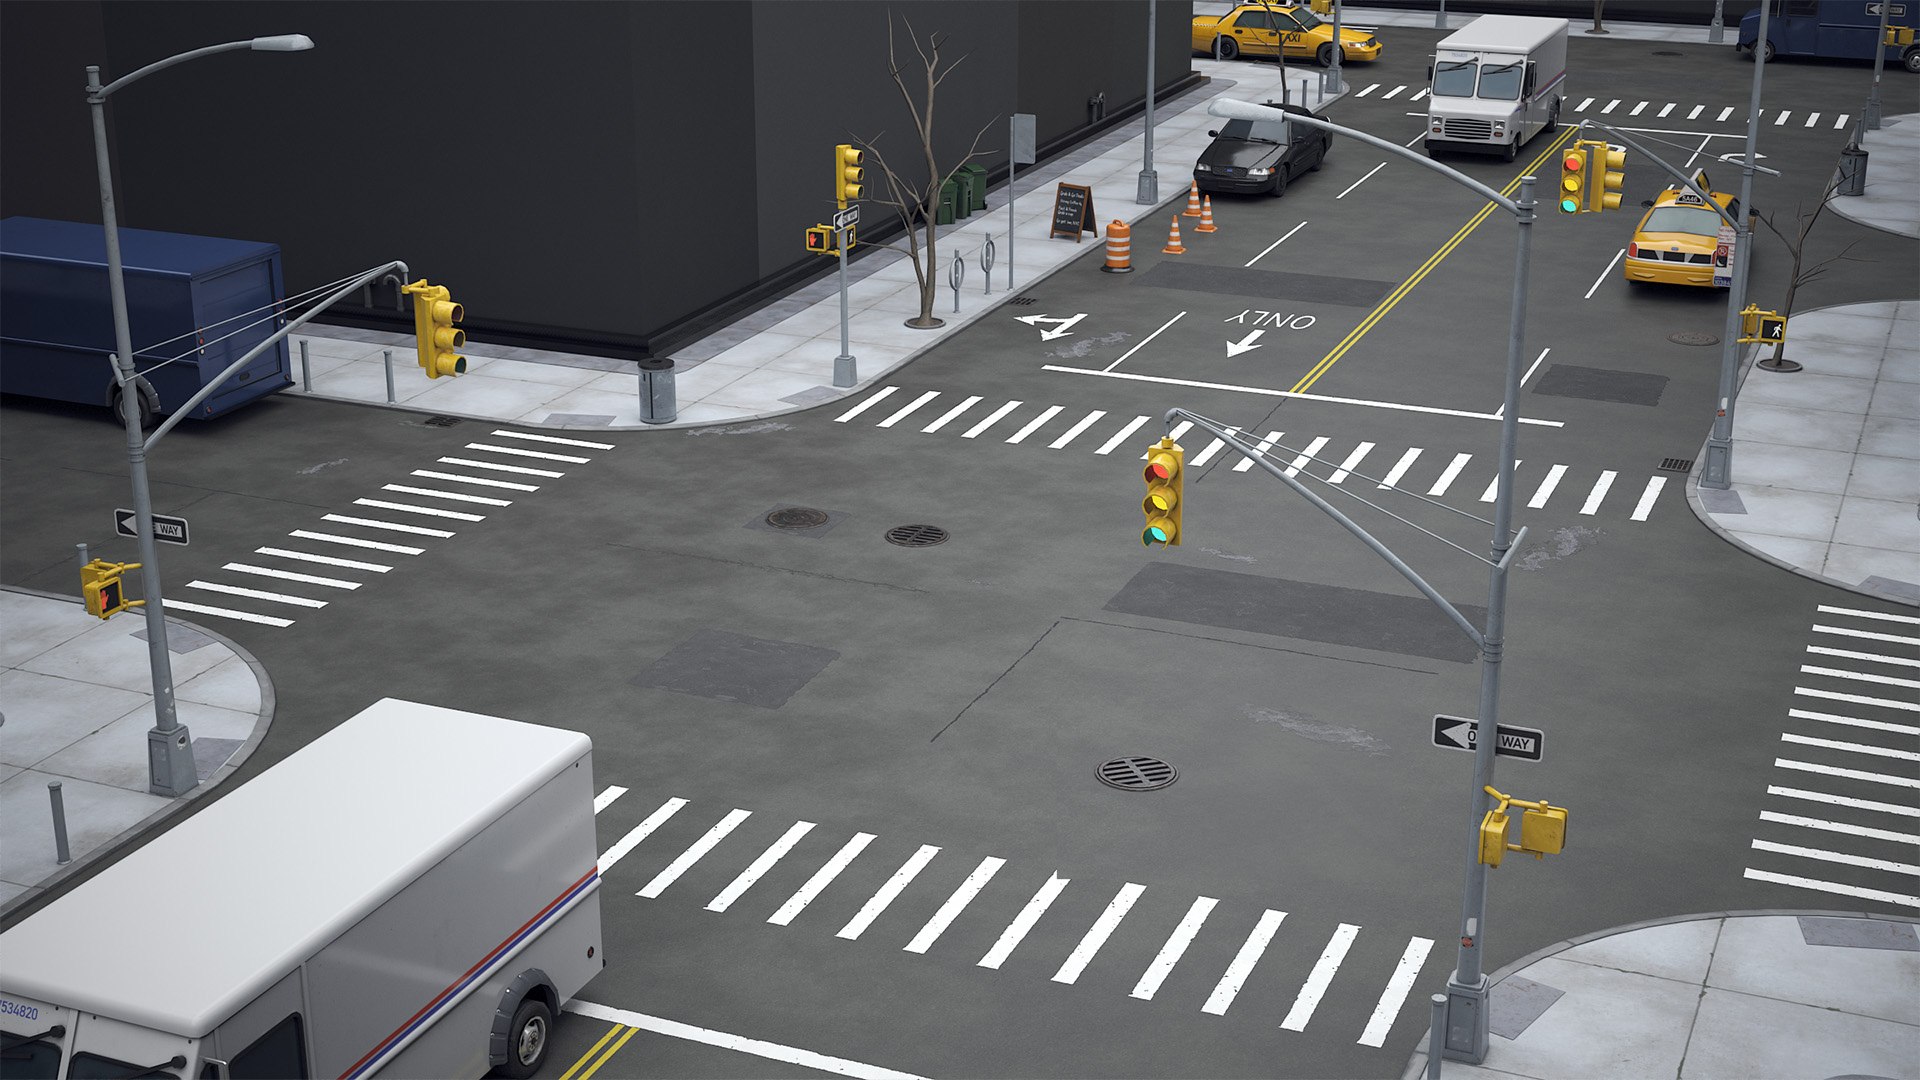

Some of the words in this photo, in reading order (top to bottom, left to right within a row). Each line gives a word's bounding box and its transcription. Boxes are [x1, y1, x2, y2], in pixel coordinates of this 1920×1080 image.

[1224, 309, 1316, 330] ONLY
[159, 524, 179, 536] WAY
[1502, 735, 1530, 750] WAY
